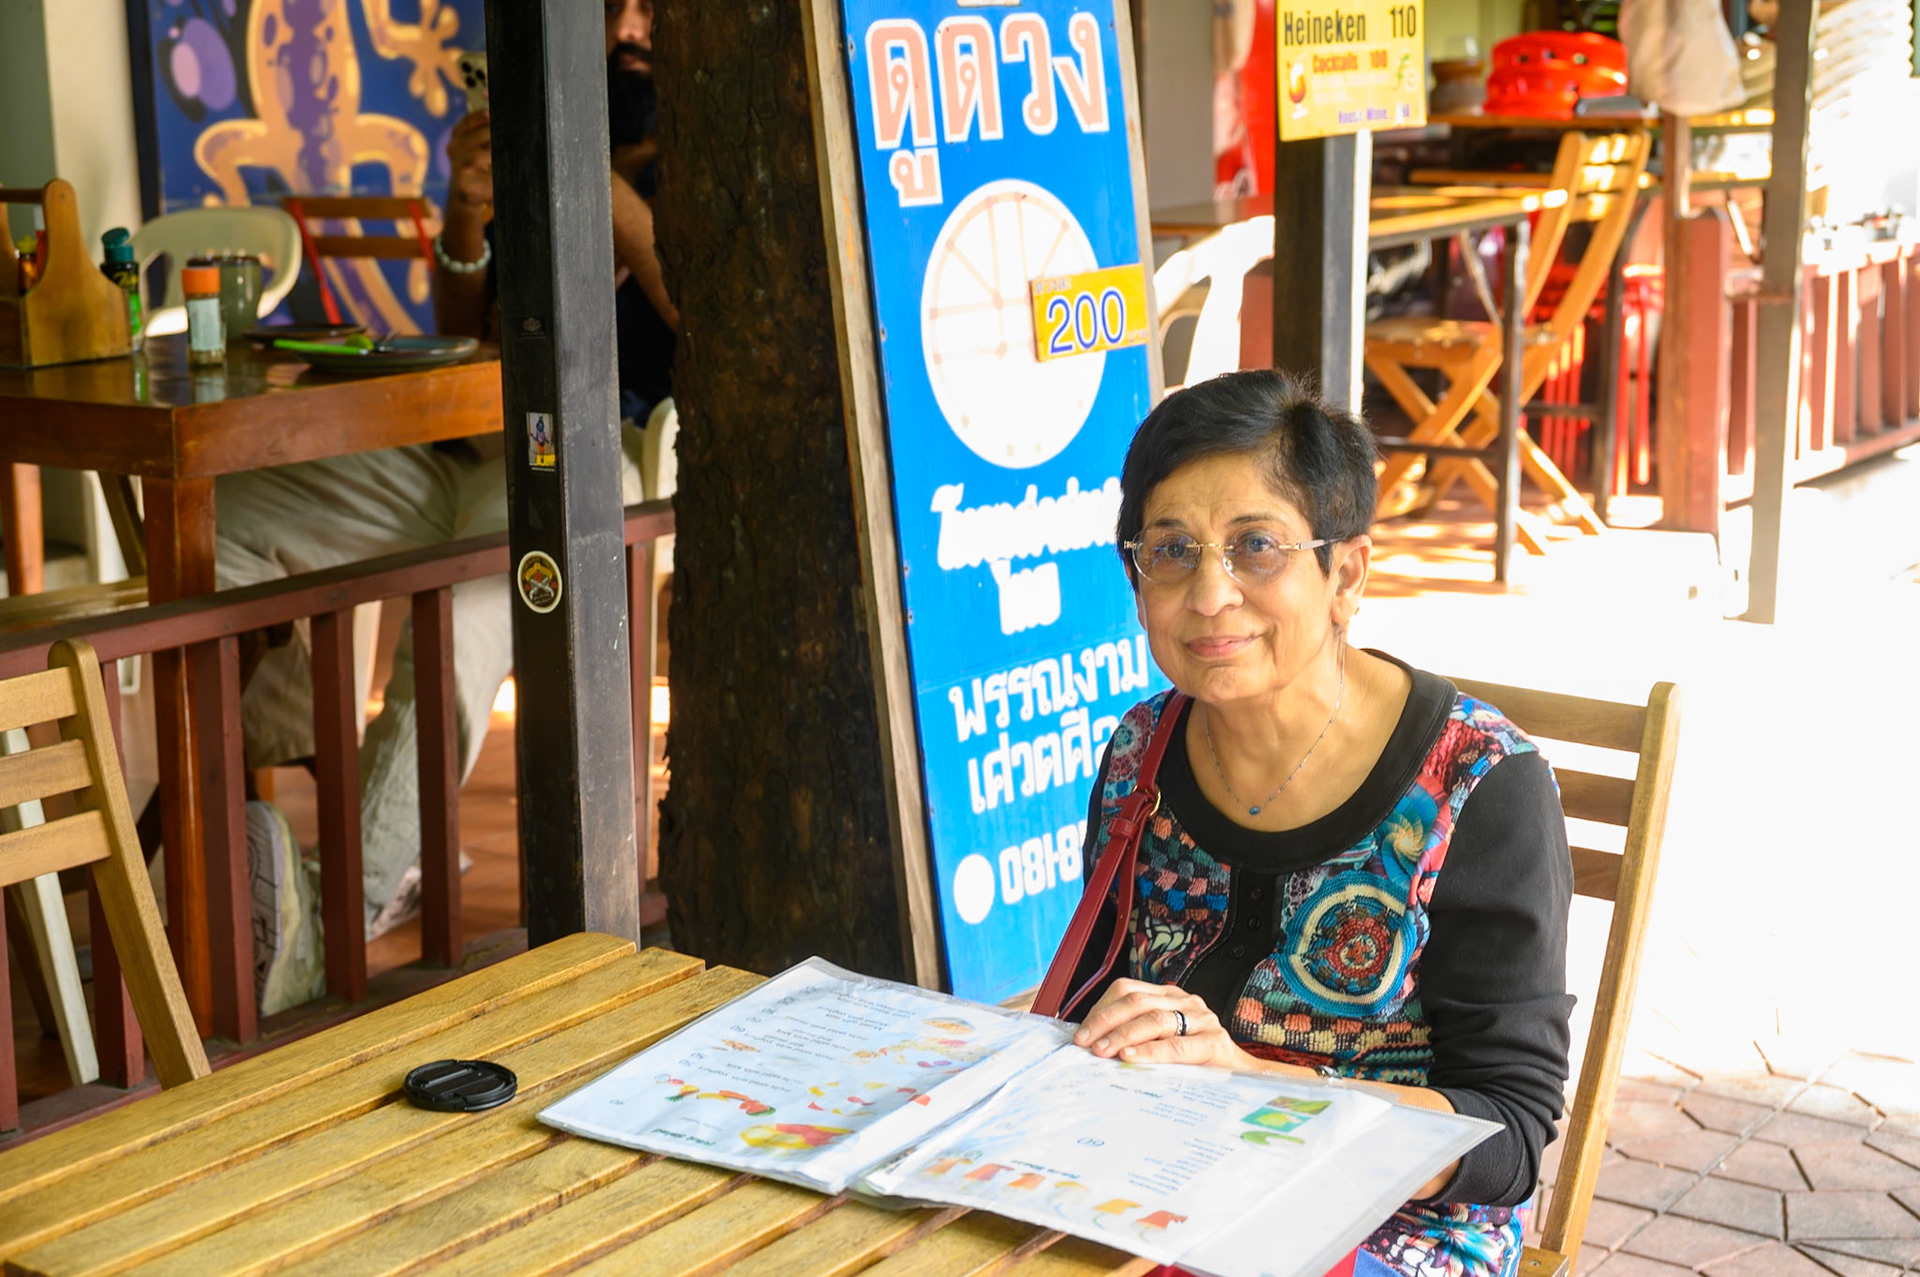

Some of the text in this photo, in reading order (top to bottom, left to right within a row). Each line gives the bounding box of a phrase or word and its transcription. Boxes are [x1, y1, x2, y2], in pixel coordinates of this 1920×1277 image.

[1284, 5, 1416, 46] Heineken 110
[865, 12, 1110, 207] ดูดวง
[1046, 286, 1127, 356] 200
[948, 633, 1149, 743] พรรณงาม
[998, 818, 1088, 905] 081-8
